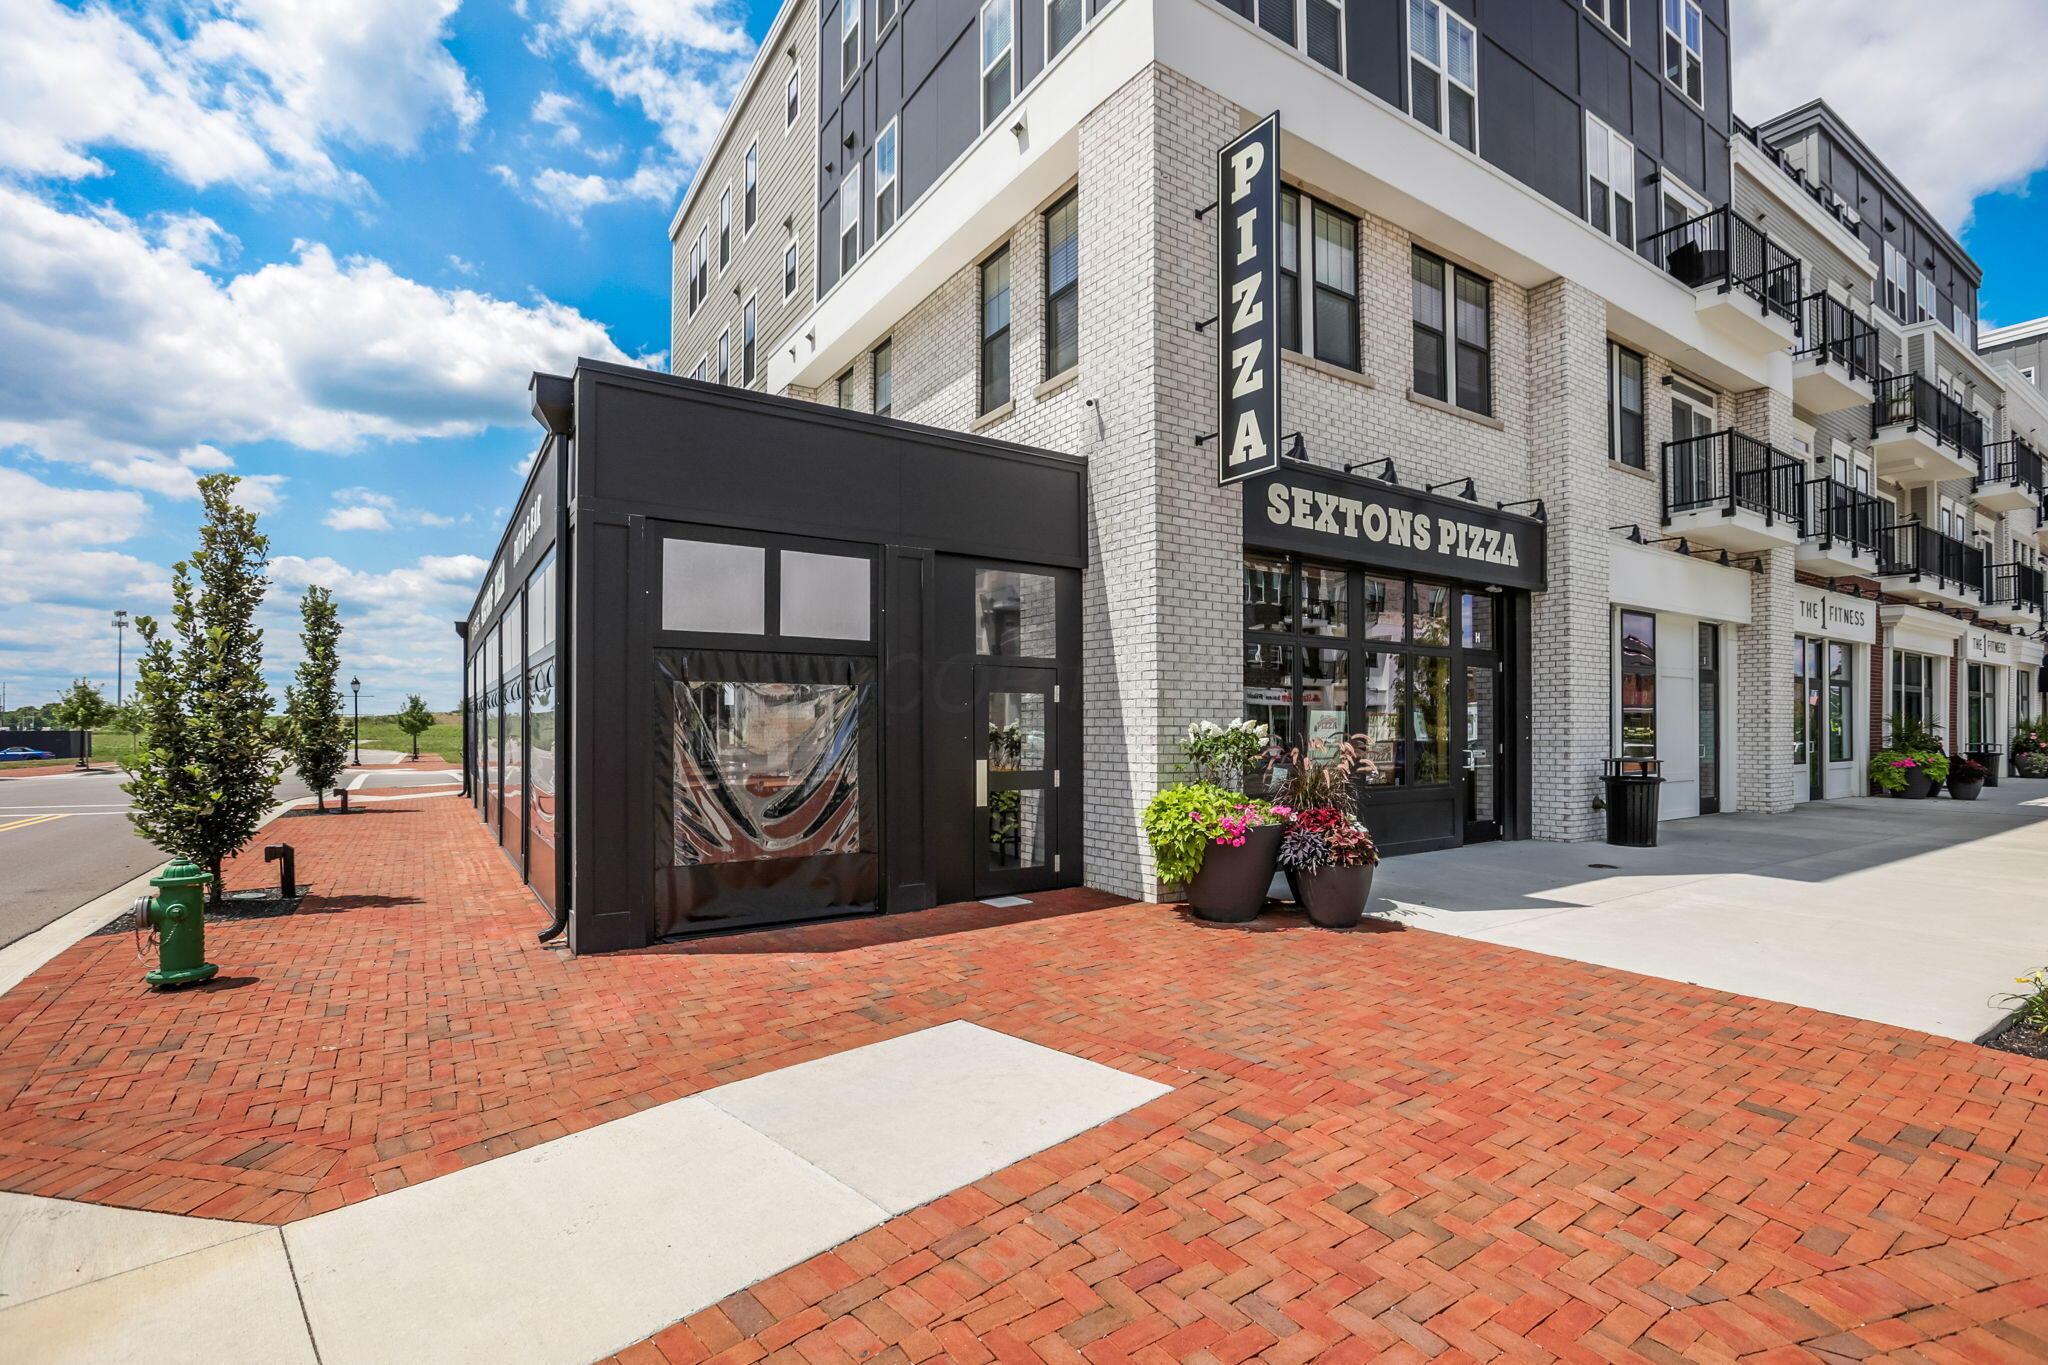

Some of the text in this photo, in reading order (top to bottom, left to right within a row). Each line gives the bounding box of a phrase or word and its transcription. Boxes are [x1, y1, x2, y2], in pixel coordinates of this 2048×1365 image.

[1229, 141, 1267, 467] PIZZA
[1267, 482, 1519, 567] SEXTONS PIZZA
[1800, 601, 1818, 619] THE
[1829, 605, 1865, 627] FITNESS
[1973, 637, 1983, 651] THE
[1987, 640, 2007, 654] FITNESS
